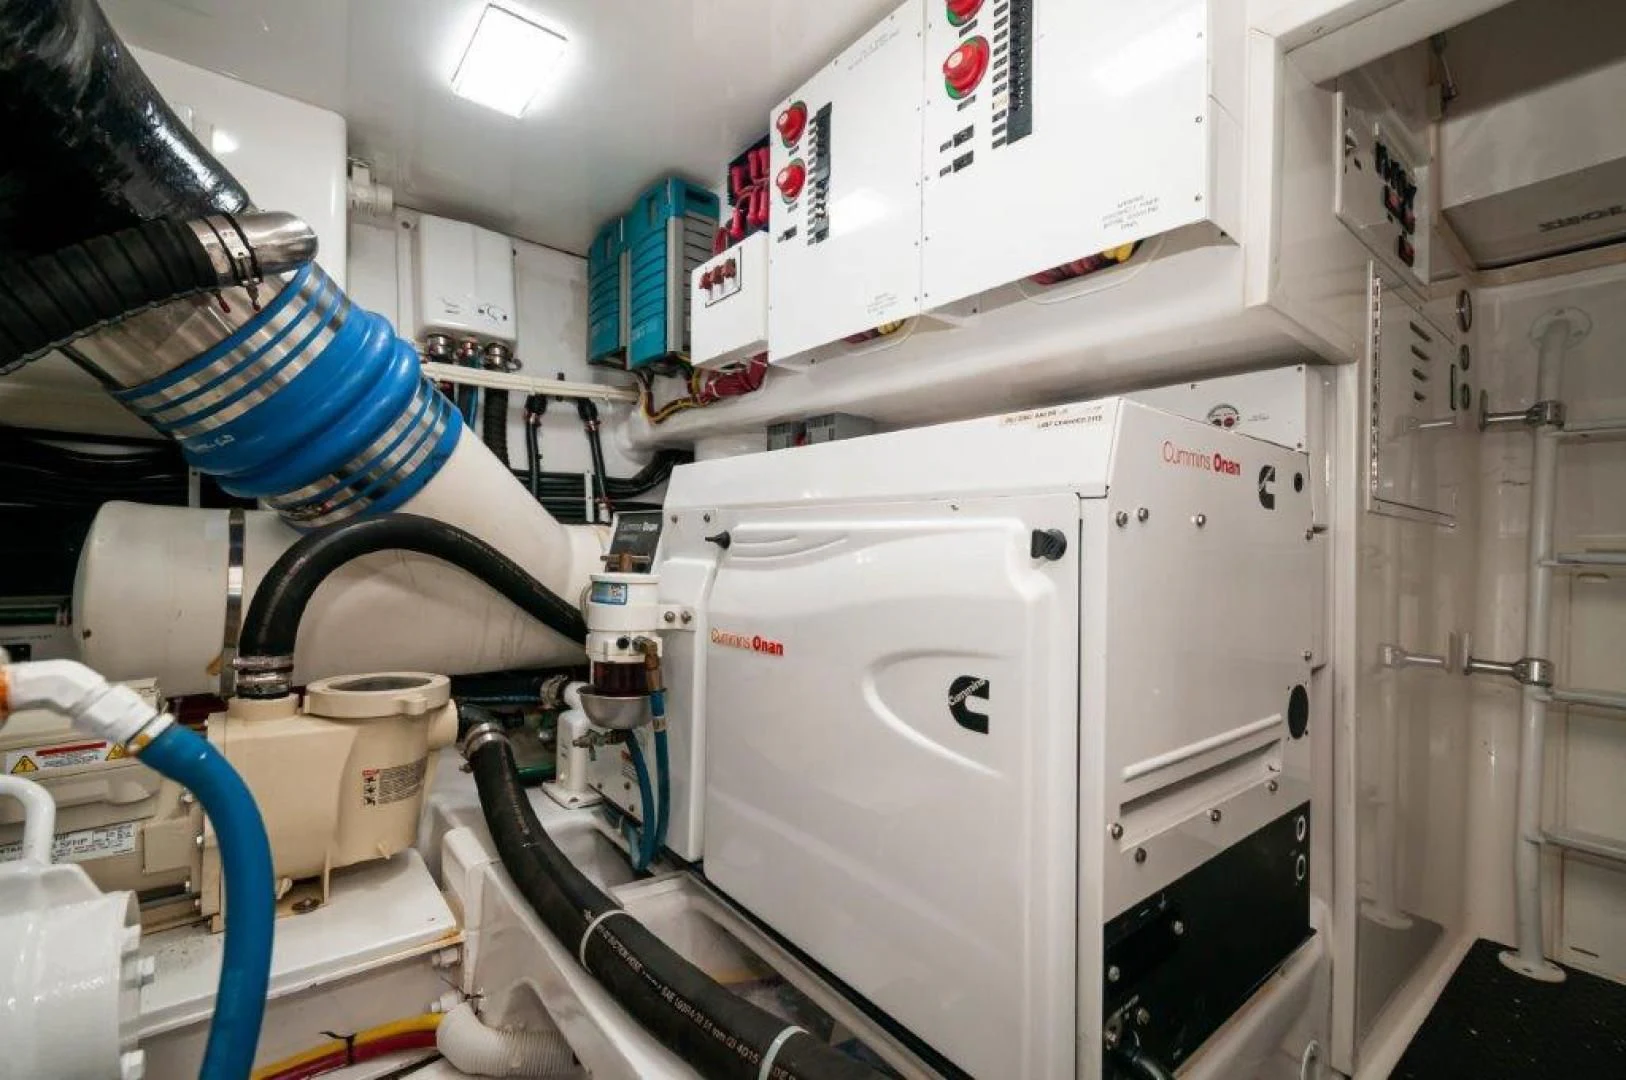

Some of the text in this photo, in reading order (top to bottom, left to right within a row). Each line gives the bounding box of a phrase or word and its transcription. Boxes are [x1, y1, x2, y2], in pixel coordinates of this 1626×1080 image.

[1163, 440, 1241, 476] Cummins Onan
[711, 627, 784, 657] Cummins Onan
